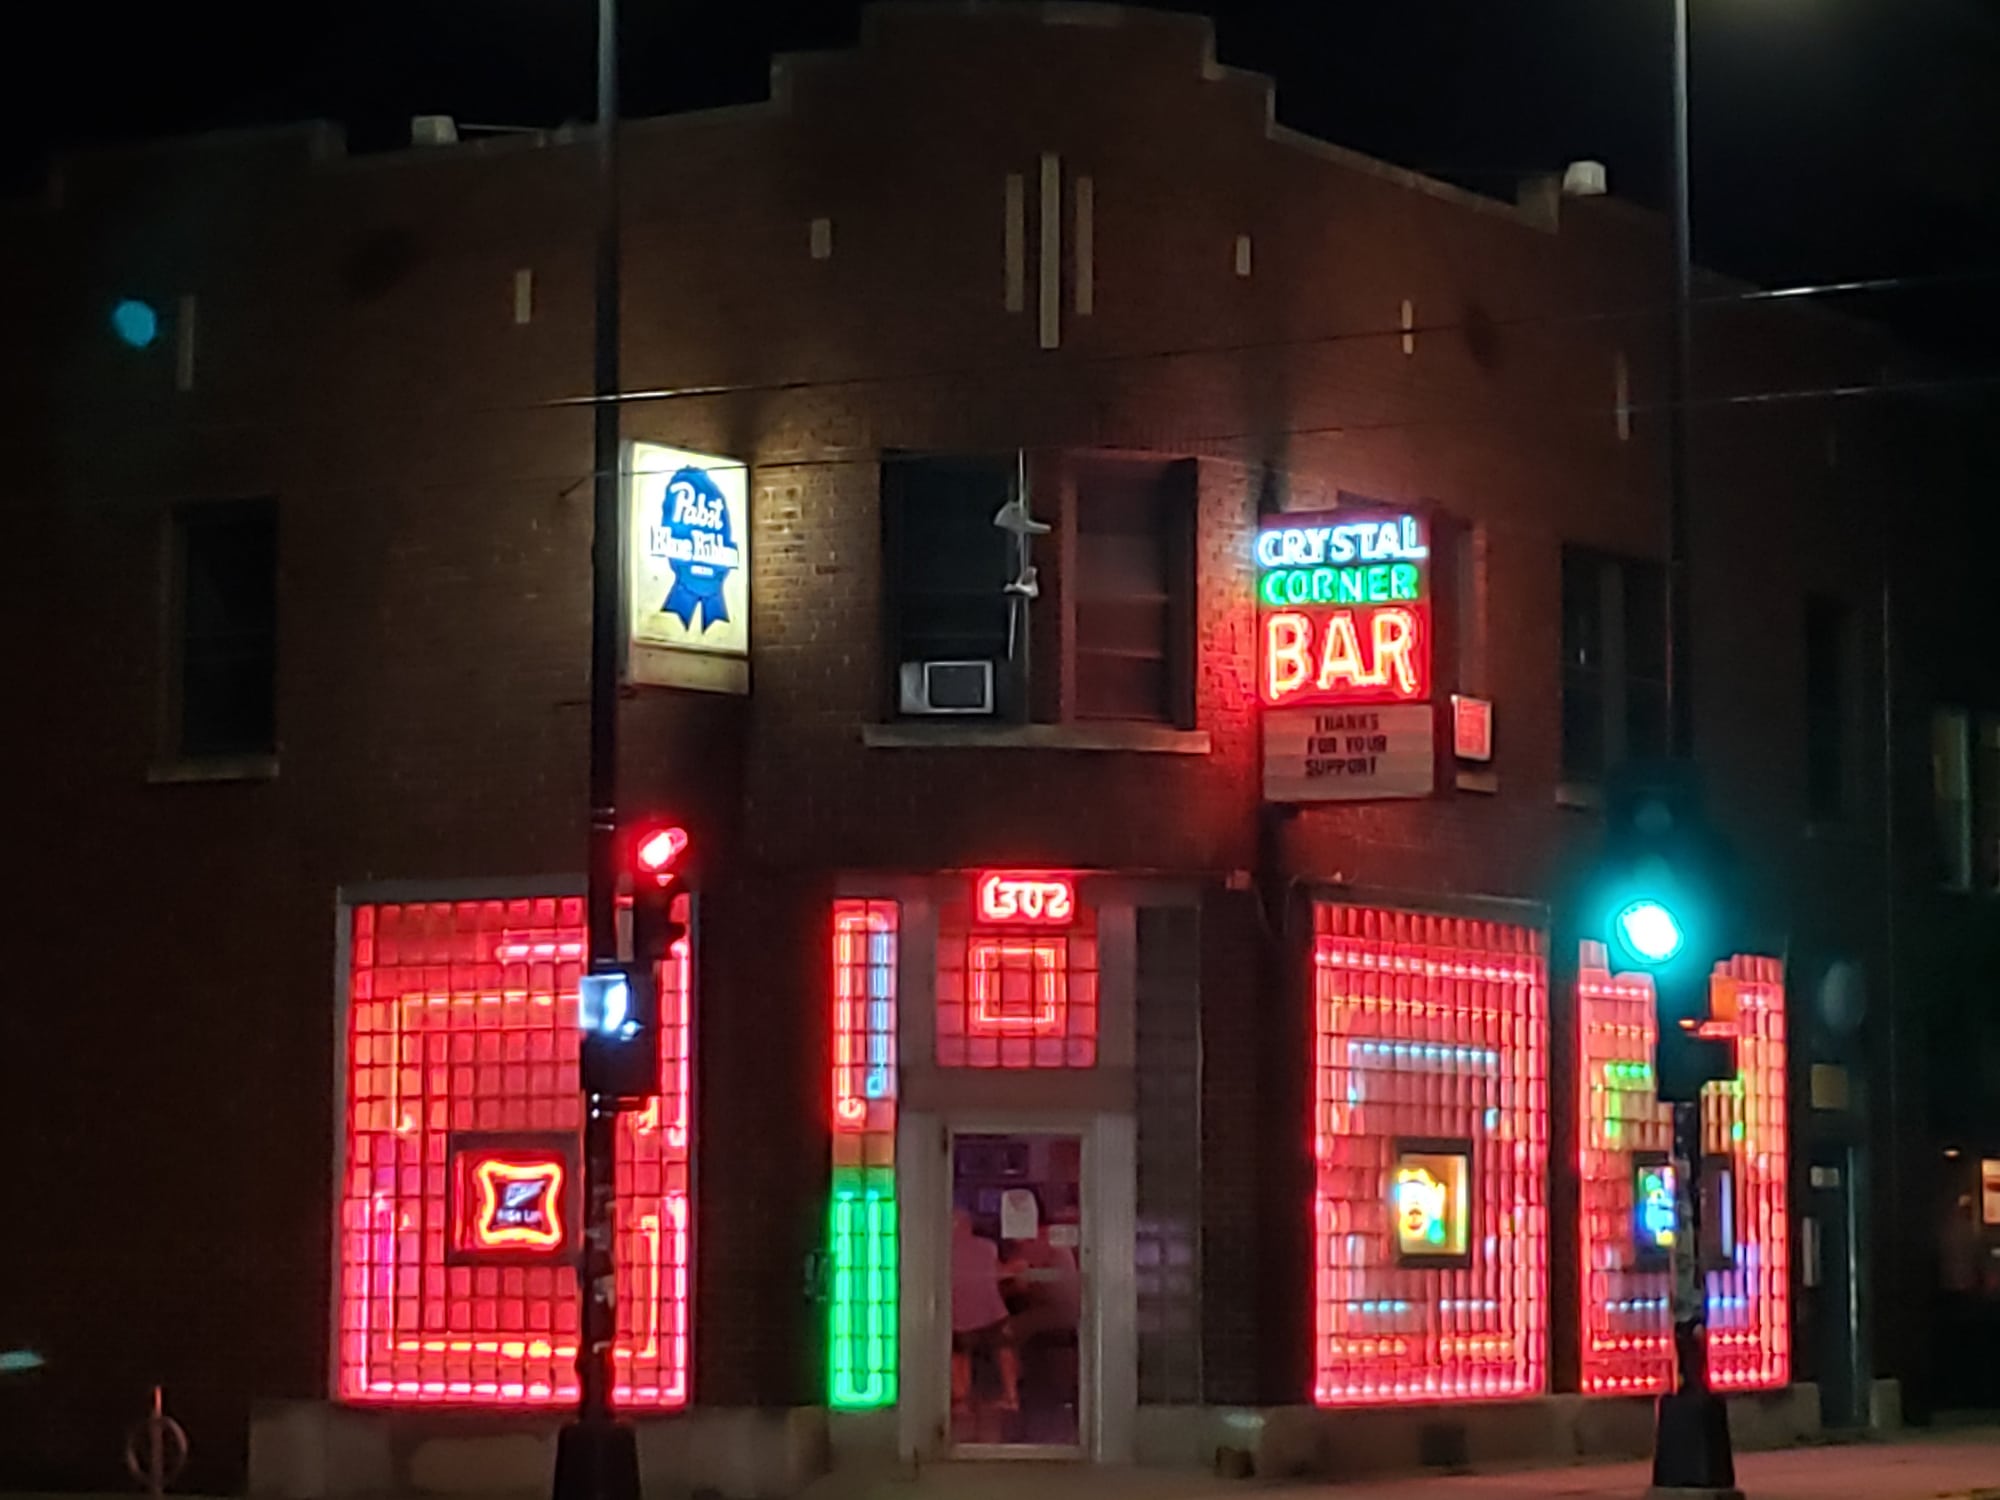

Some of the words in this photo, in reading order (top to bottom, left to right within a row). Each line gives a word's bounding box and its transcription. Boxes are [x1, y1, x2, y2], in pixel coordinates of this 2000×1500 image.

[669, 480, 725, 530] Pabst
[652, 526, 692, 560] Blue
[1255, 515, 1429, 567] CRYSTAL
[1261, 562, 1419, 605] CORNER
[1266, 607, 1421, 701] BAR
[1314, 713, 1380, 732] THANKS
[1307, 736, 1337, 755] FOR
[1346, 734, 1388, 754] YOUR
[1304, 756, 1377, 778] SUPPORT
